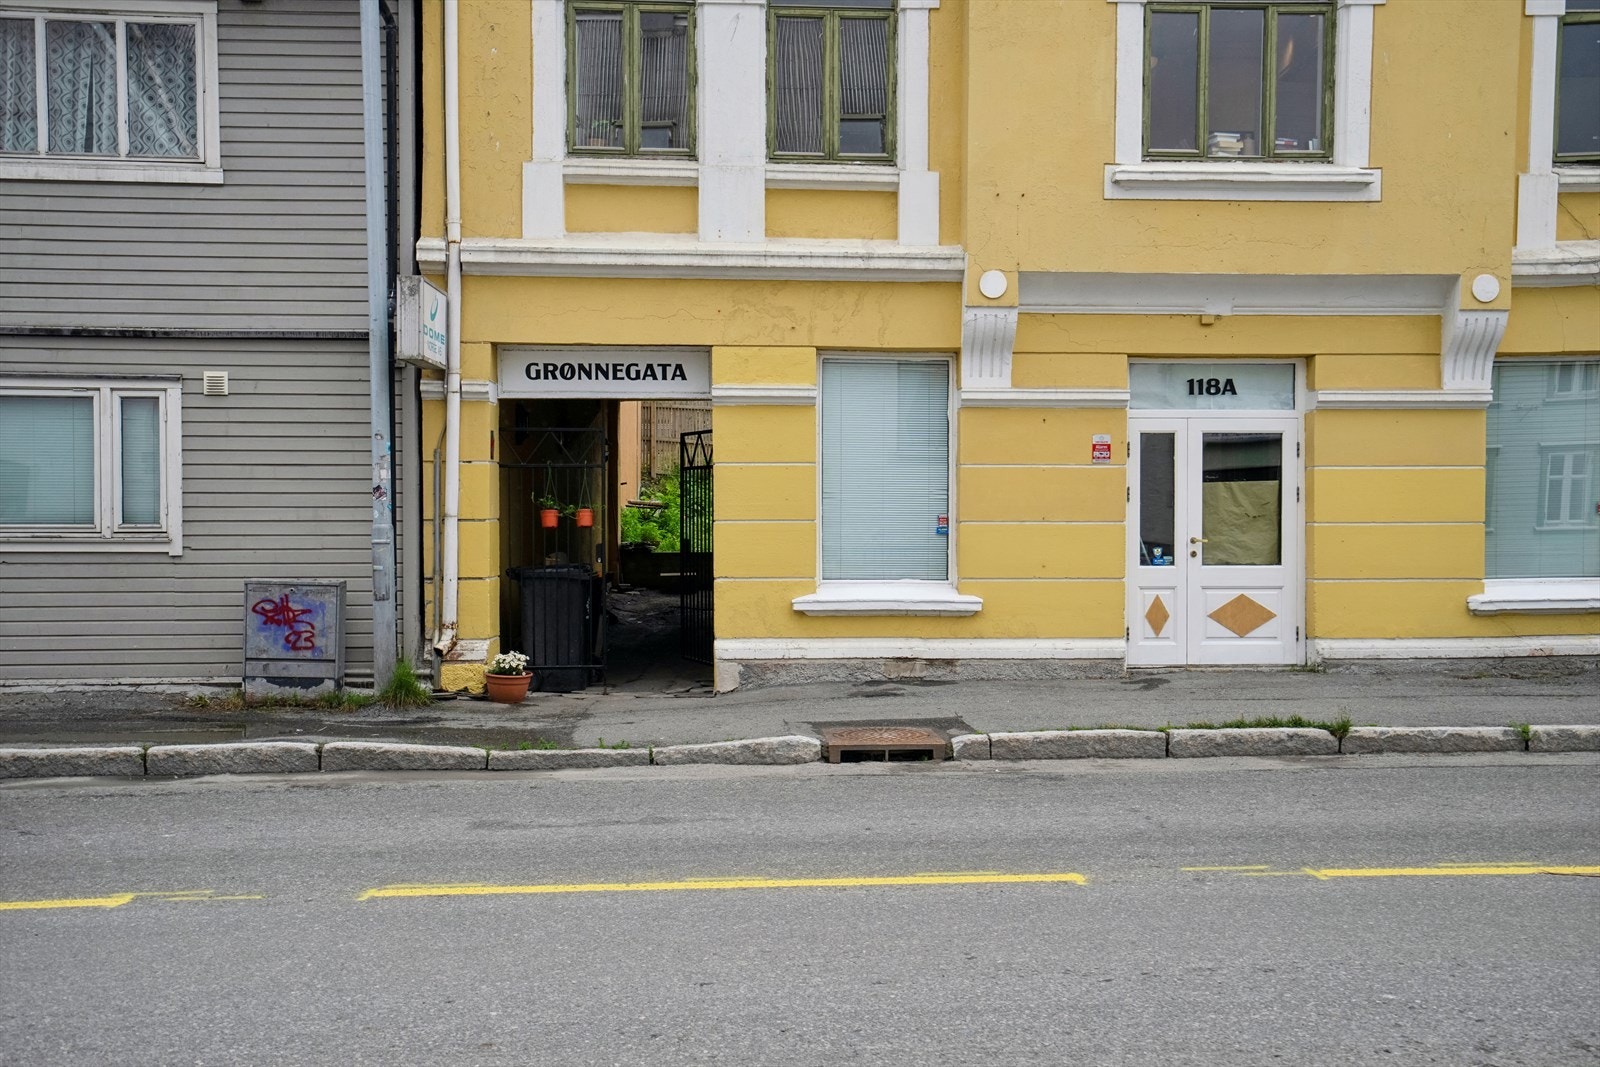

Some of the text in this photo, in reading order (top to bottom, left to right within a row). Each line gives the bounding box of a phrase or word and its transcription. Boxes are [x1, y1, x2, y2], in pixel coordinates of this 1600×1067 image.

[423, 324, 445, 345] DOME
[525, 362, 688, 381] GRØNNEGATA
[1186, 378, 1238, 396] 118A
